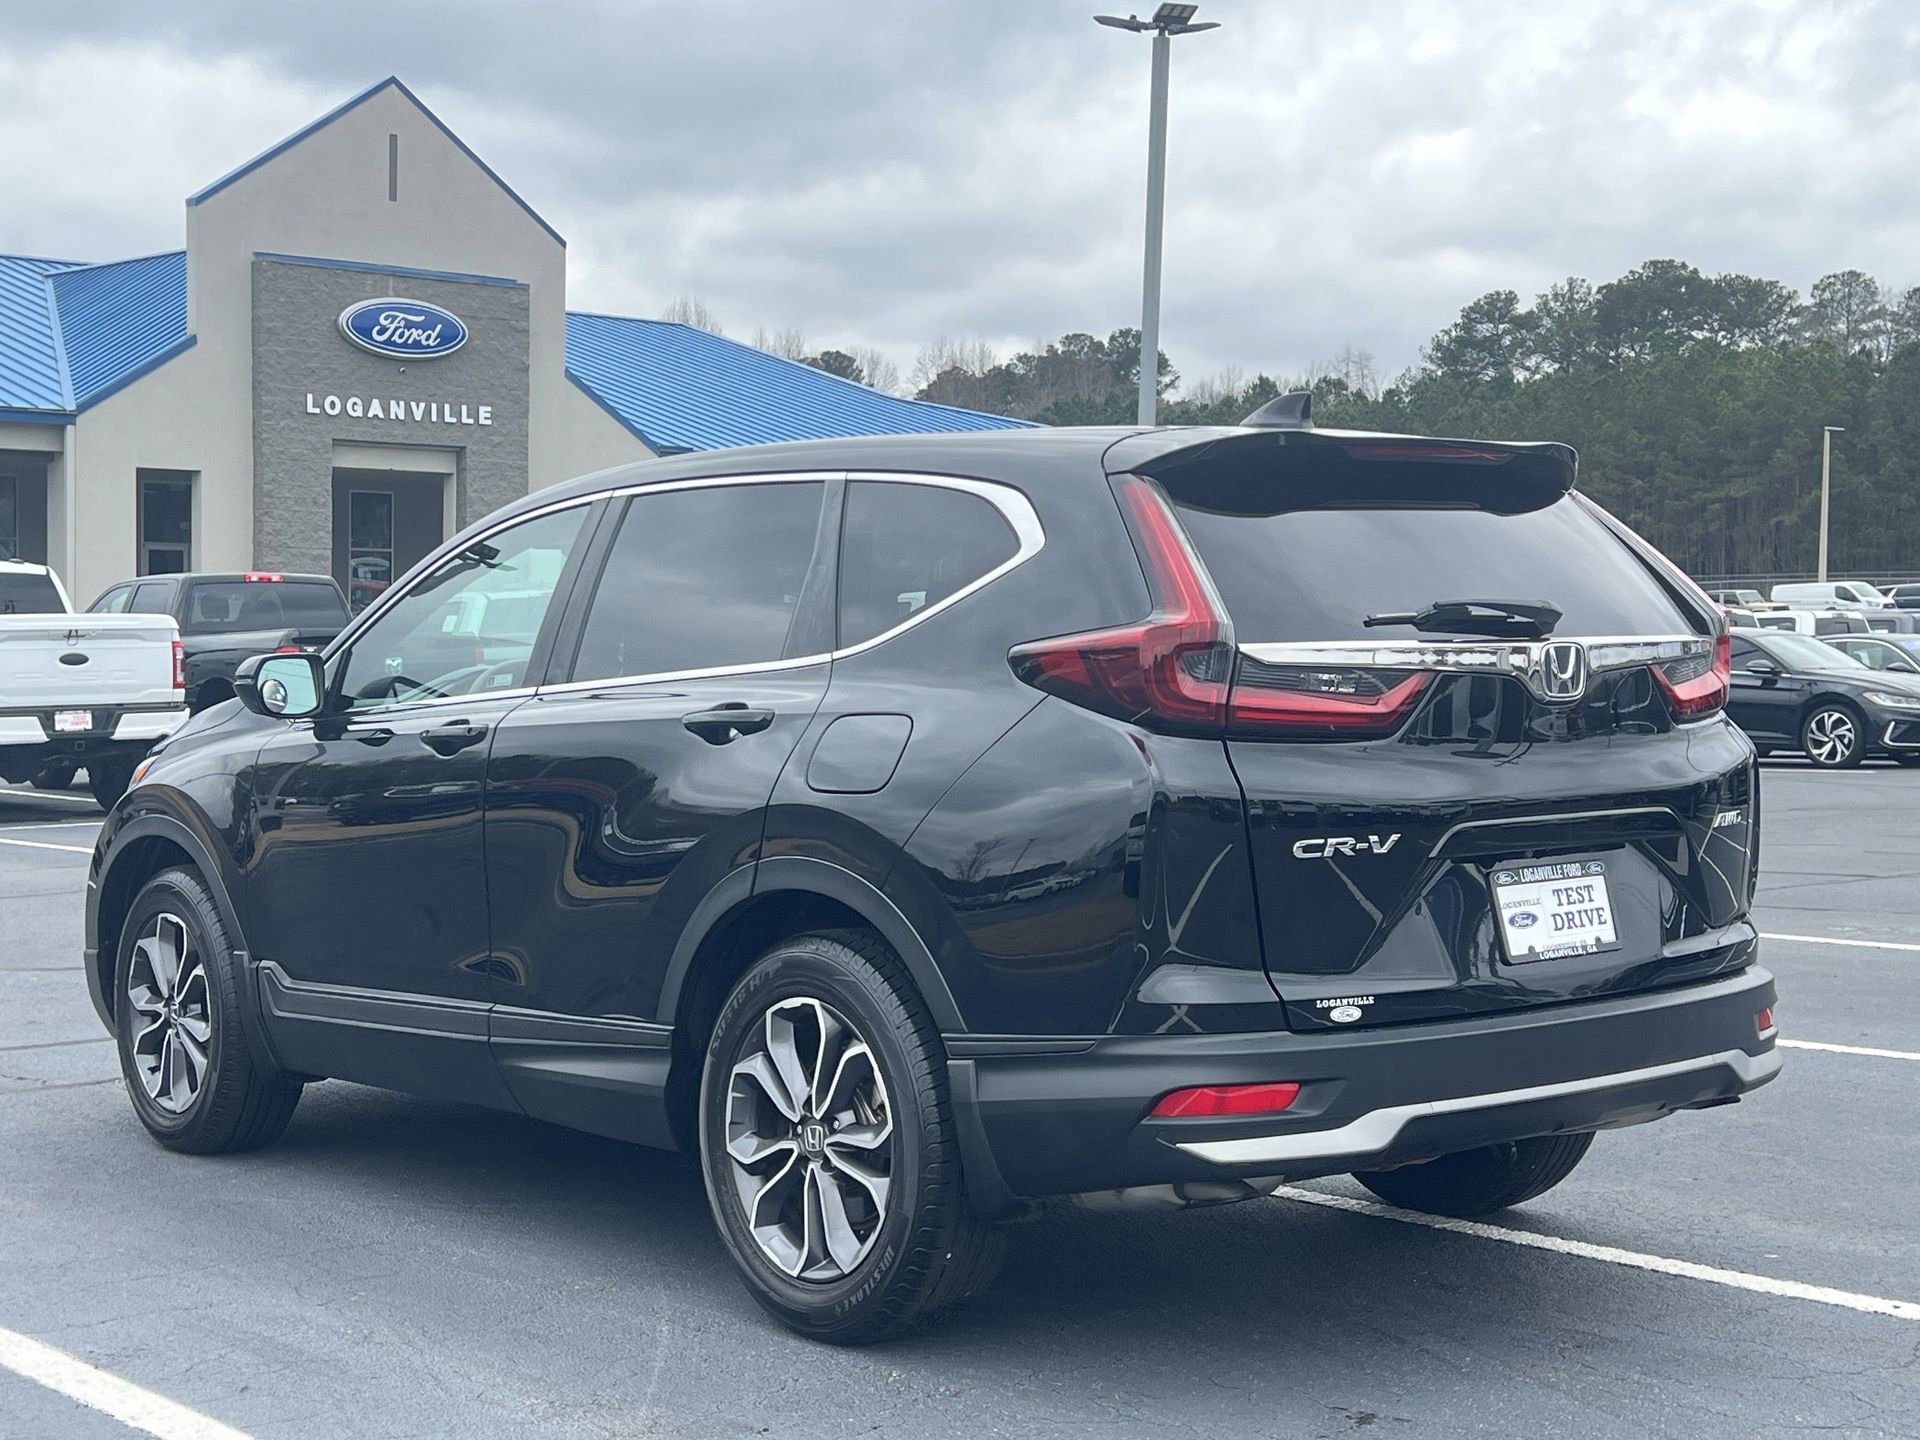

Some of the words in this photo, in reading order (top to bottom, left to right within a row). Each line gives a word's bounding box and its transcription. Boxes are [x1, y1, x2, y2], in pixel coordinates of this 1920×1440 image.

[371, 311, 443, 347] Ford
[306, 393, 492, 425] LOGANVILLE
[1293, 833, 1401, 858] CR-V
[1519, 867, 1562, 882] LOGANVILLE
[1563, 863, 1582, 878] FORD
[1552, 884, 1595, 907] TEST
[1551, 907, 1608, 931] DRIVE
[1540, 946, 1586, 960] LOGANVILLE,
[1586, 944, 1598, 953] GA
[1316, 996, 1375, 1008] LOGANVILLE
[843, 1245, 895, 1312] WESTLAKE
